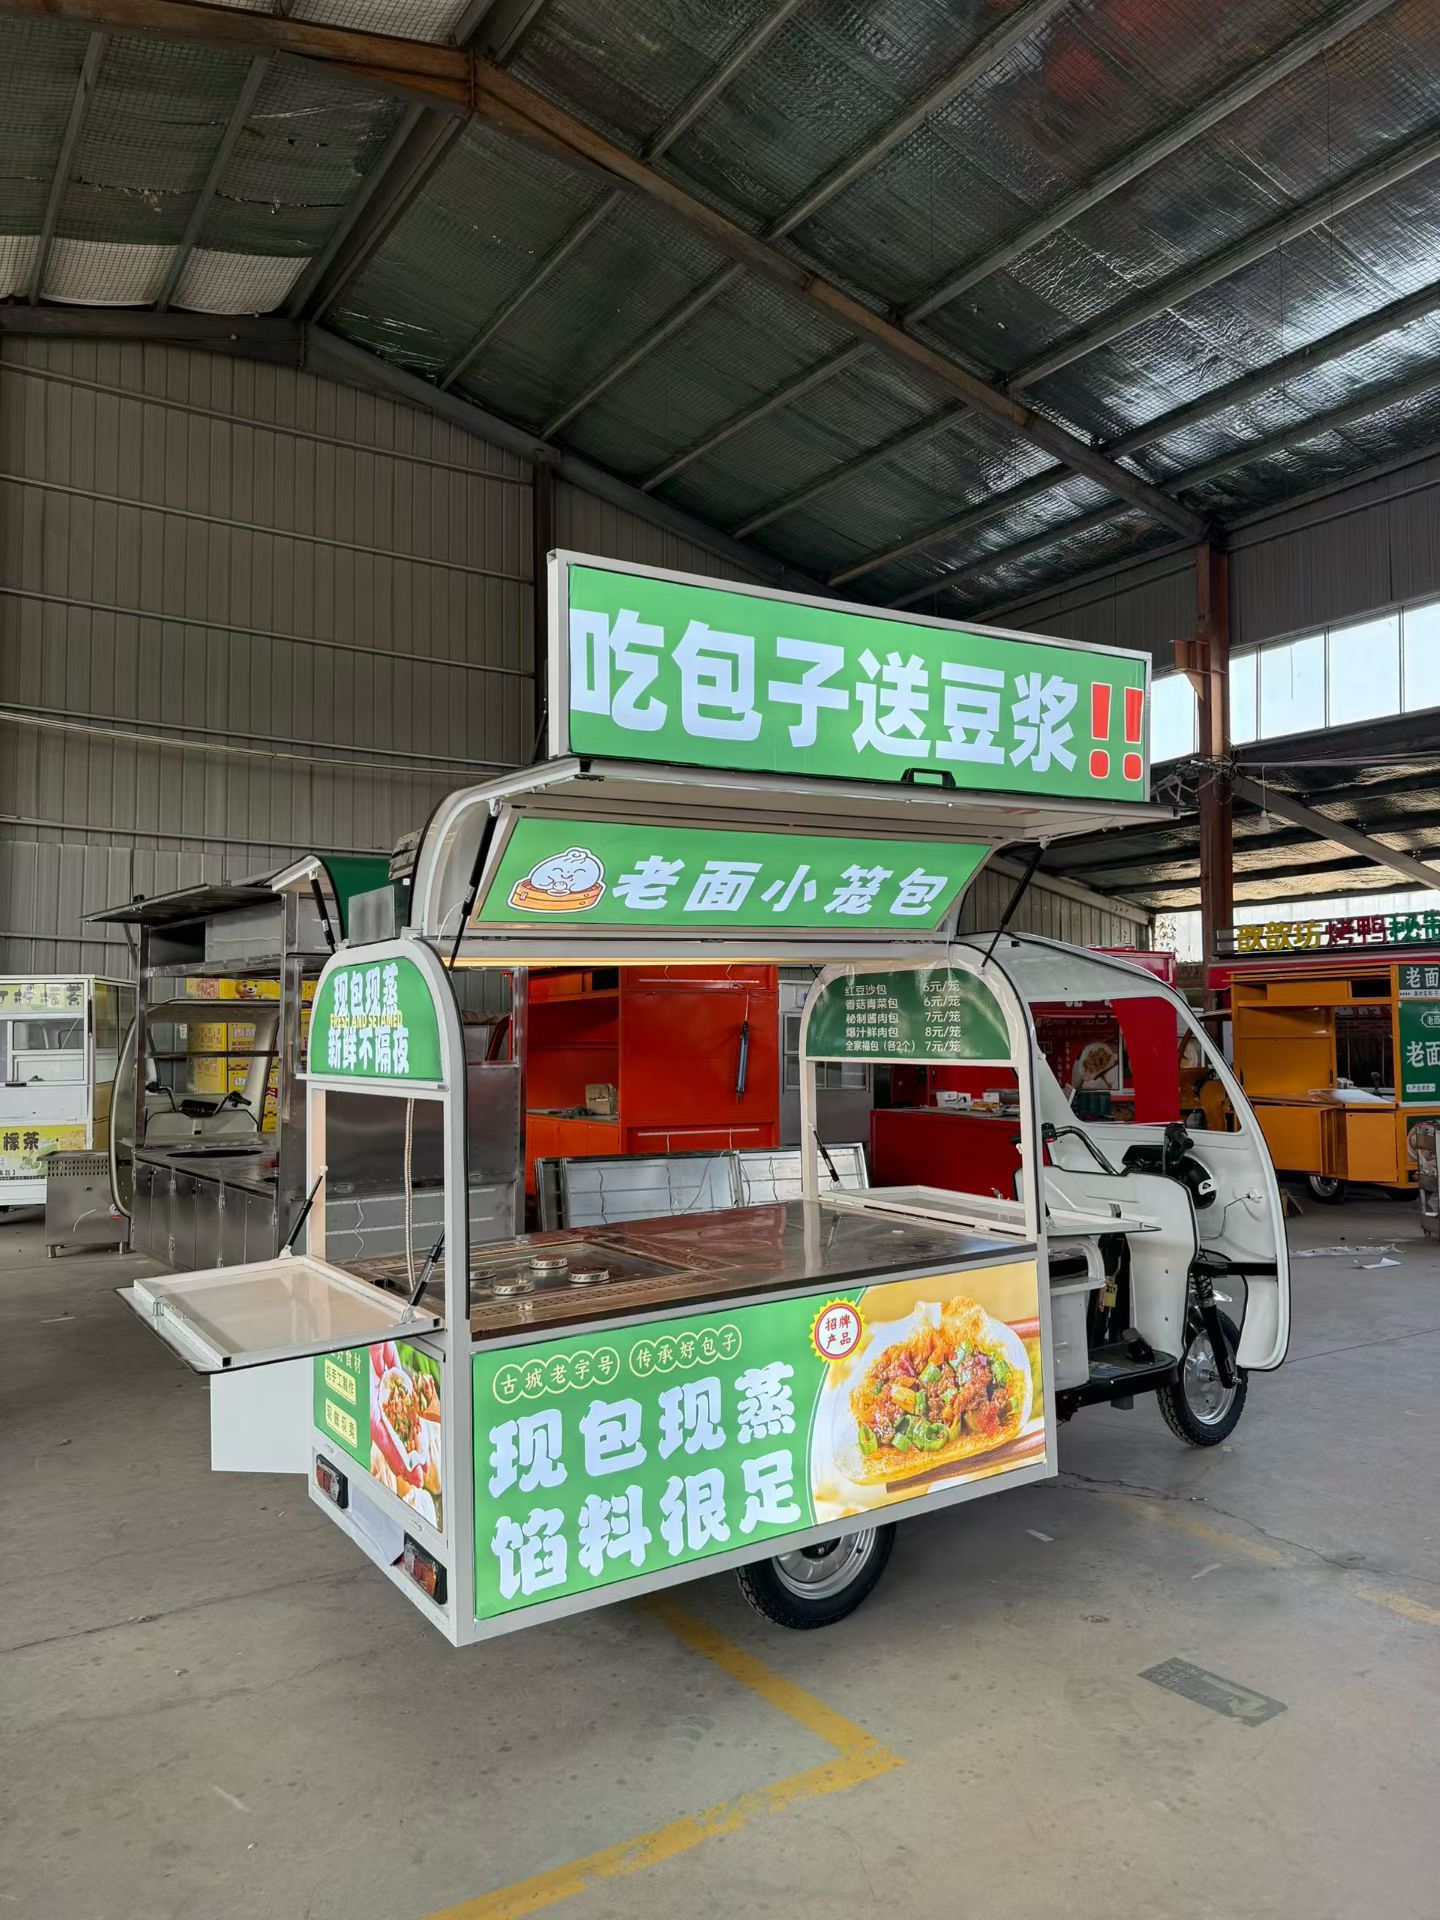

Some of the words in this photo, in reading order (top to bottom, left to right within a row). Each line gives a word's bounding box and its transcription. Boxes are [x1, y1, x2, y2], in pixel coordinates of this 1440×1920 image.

[612, 855, 949, 916] 老面小笼包
[1405, 967, 1439, 988] 老面
[333, 962, 399, 1017] 现包现蒸
[845, 984, 887, 996] 红豆沙包
[923, 980, 960, 992] 6元/笼
[846, 998, 899, 1010] 香菇青菜包
[923, 995, 961, 1007] 6元/笼
[351, 1012, 367, 1029] AND
[846, 1012, 900, 1024] 秘制酱肉包
[925, 1011, 961, 1023] 7元/笼
[845, 1026, 900, 1038] 爆汁鲜肉包
[925, 1025, 962, 1038] 8元/笼
[328, 1024, 410, 1075] 新鲜不隔夜
[925, 1040, 961, 1053] 7元/笼
[825, 1313, 852, 1332] 招牌
[825, 1332, 852, 1350] 产品
[500, 1354, 616, 1395] 古城老字号
[636, 1333, 738, 1370] 传承好包子
[488, 1361, 797, 1498] 现包现蒸
[490, 1449, 802, 1600] 馅料很足
